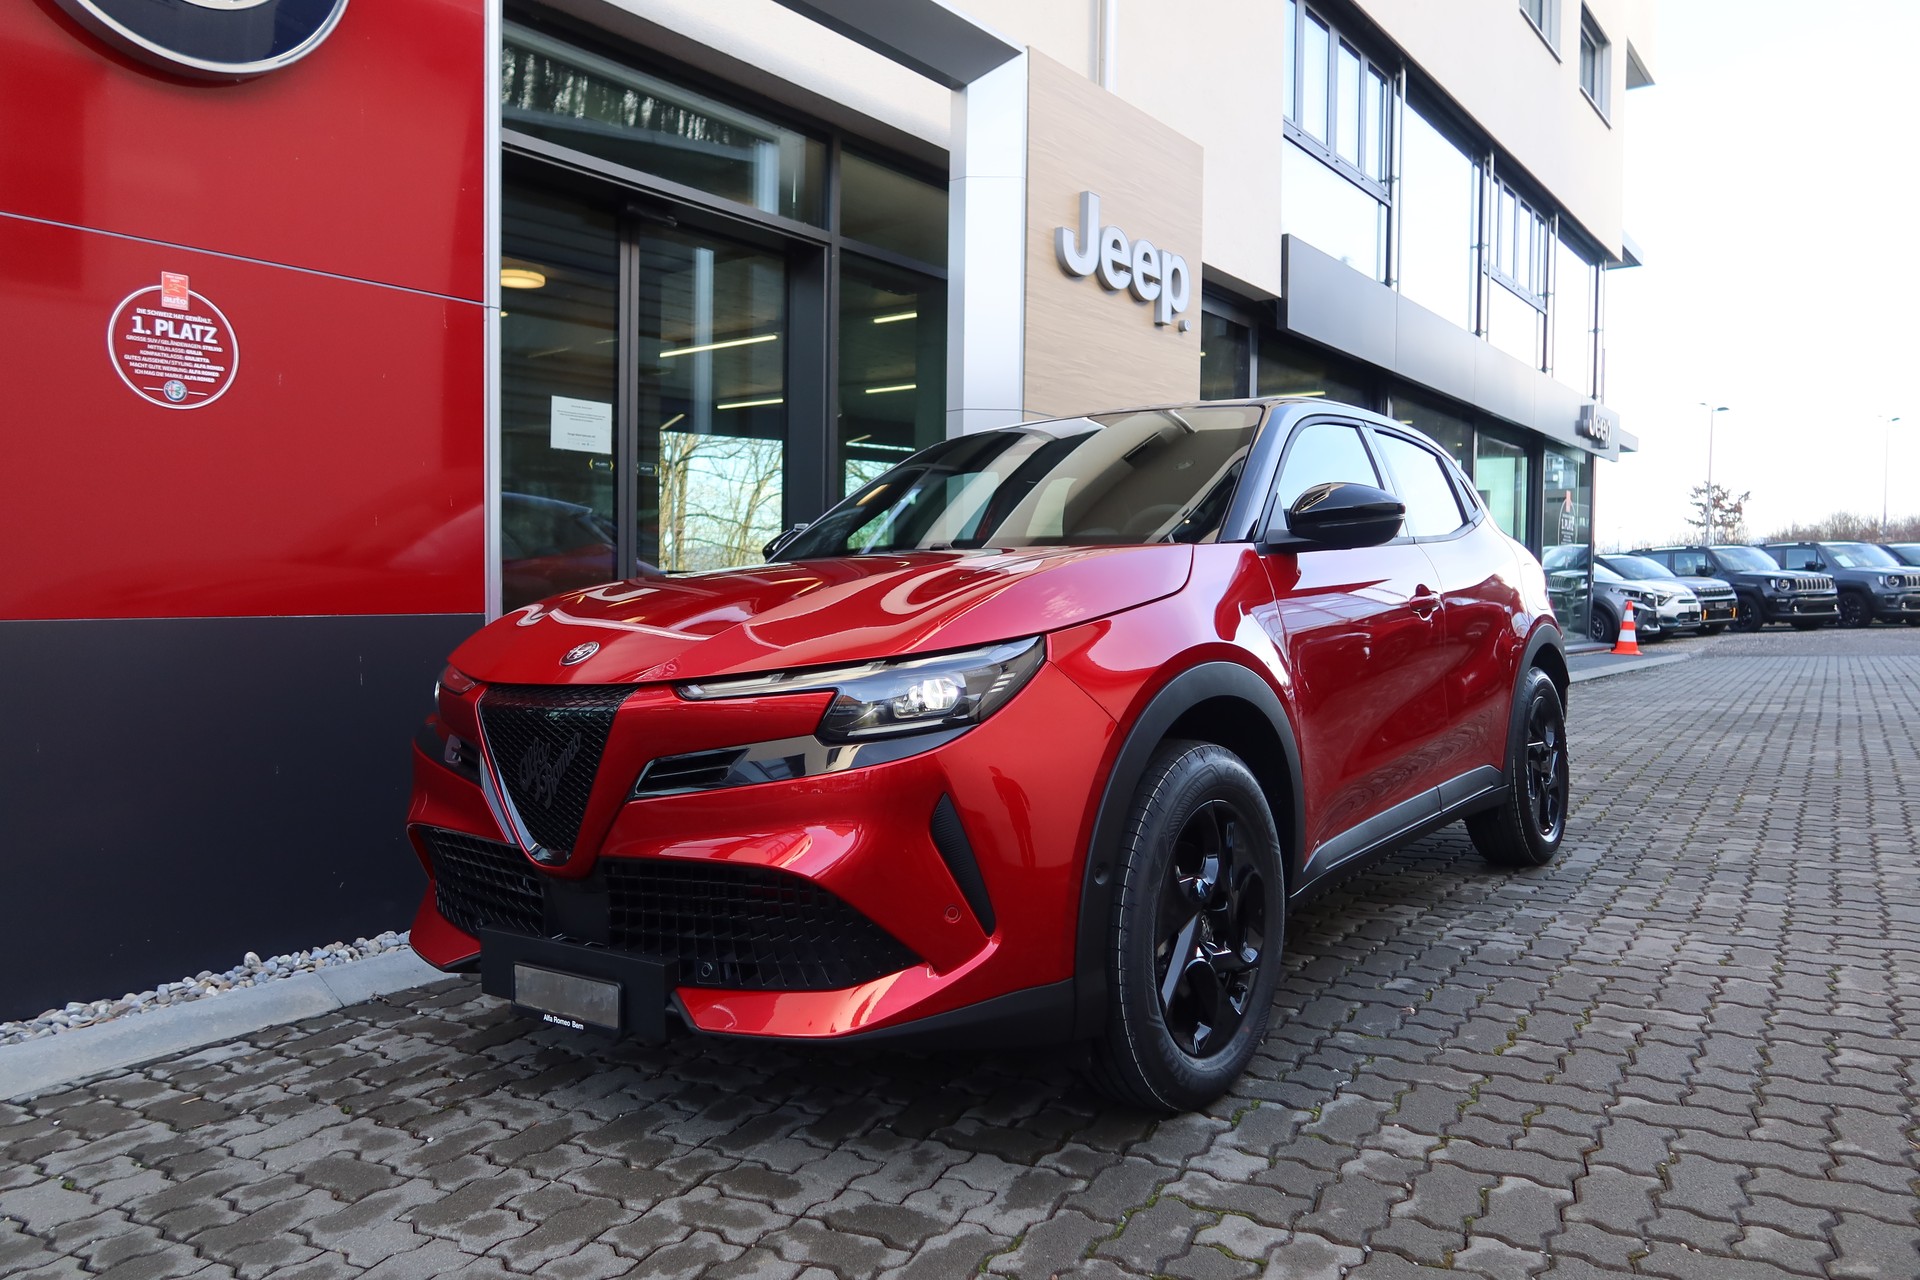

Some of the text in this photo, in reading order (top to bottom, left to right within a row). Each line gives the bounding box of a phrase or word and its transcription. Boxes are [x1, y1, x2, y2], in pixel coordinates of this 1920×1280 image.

[1055, 191, 1190, 326] Jeep
[146, 309, 173, 318] SCHWEIZ
[132, 315, 218, 344] 1. PLATZ
[1584, 405, 1611, 449] Jeep
[543, 1013, 584, 1031] Alfa Romeo Bern
